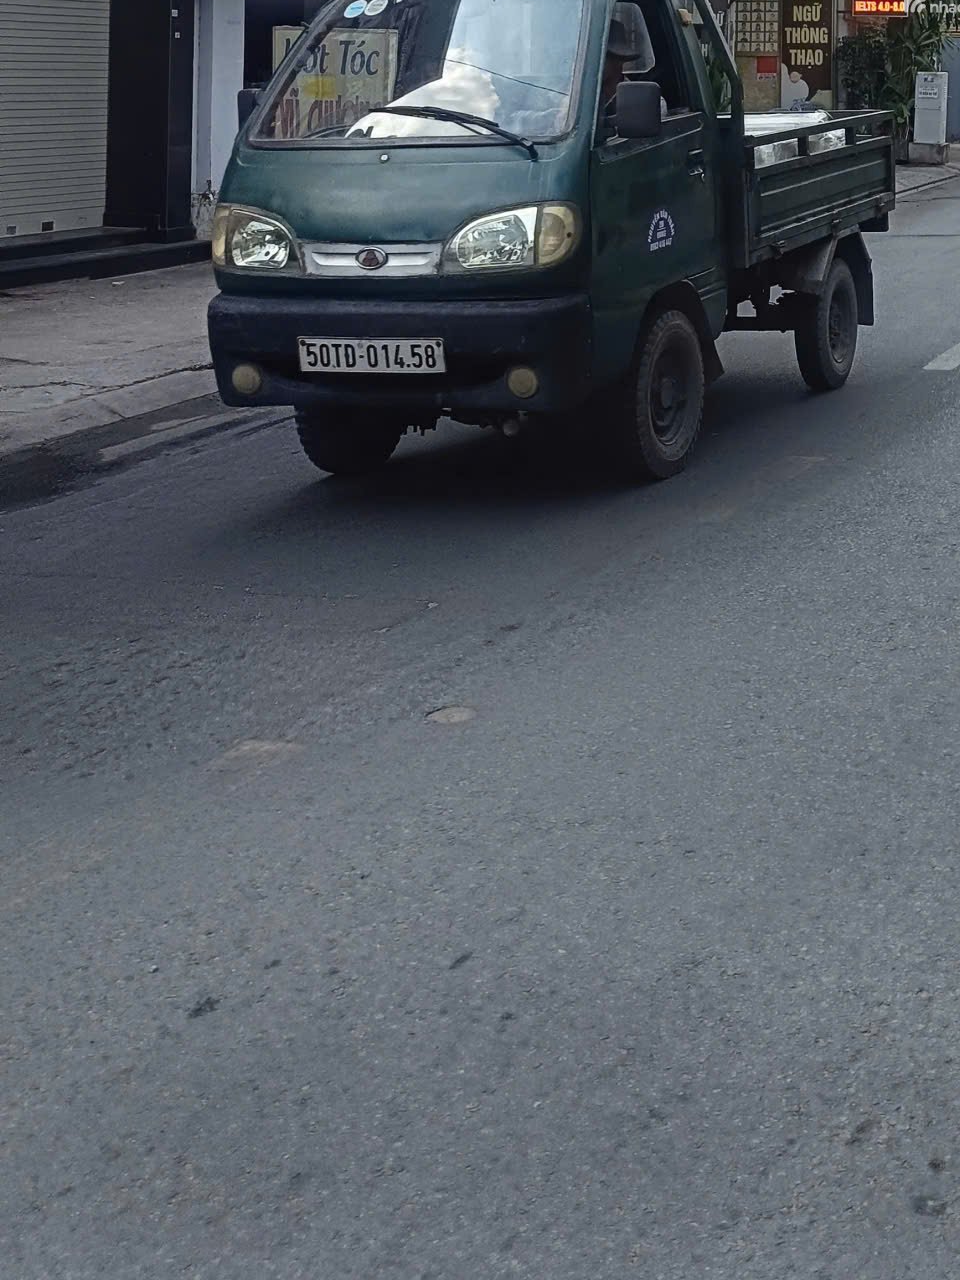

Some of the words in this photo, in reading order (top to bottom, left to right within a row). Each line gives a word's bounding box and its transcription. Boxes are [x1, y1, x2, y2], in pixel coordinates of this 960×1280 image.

[793, 2, 822, 22] NGỮ
[784, 24, 829, 44] THÔNG
[339, 40, 380, 76] Tóc
[789, 49, 823, 69] THẠO
[305, 343, 437, 369] 50TD-014.58
